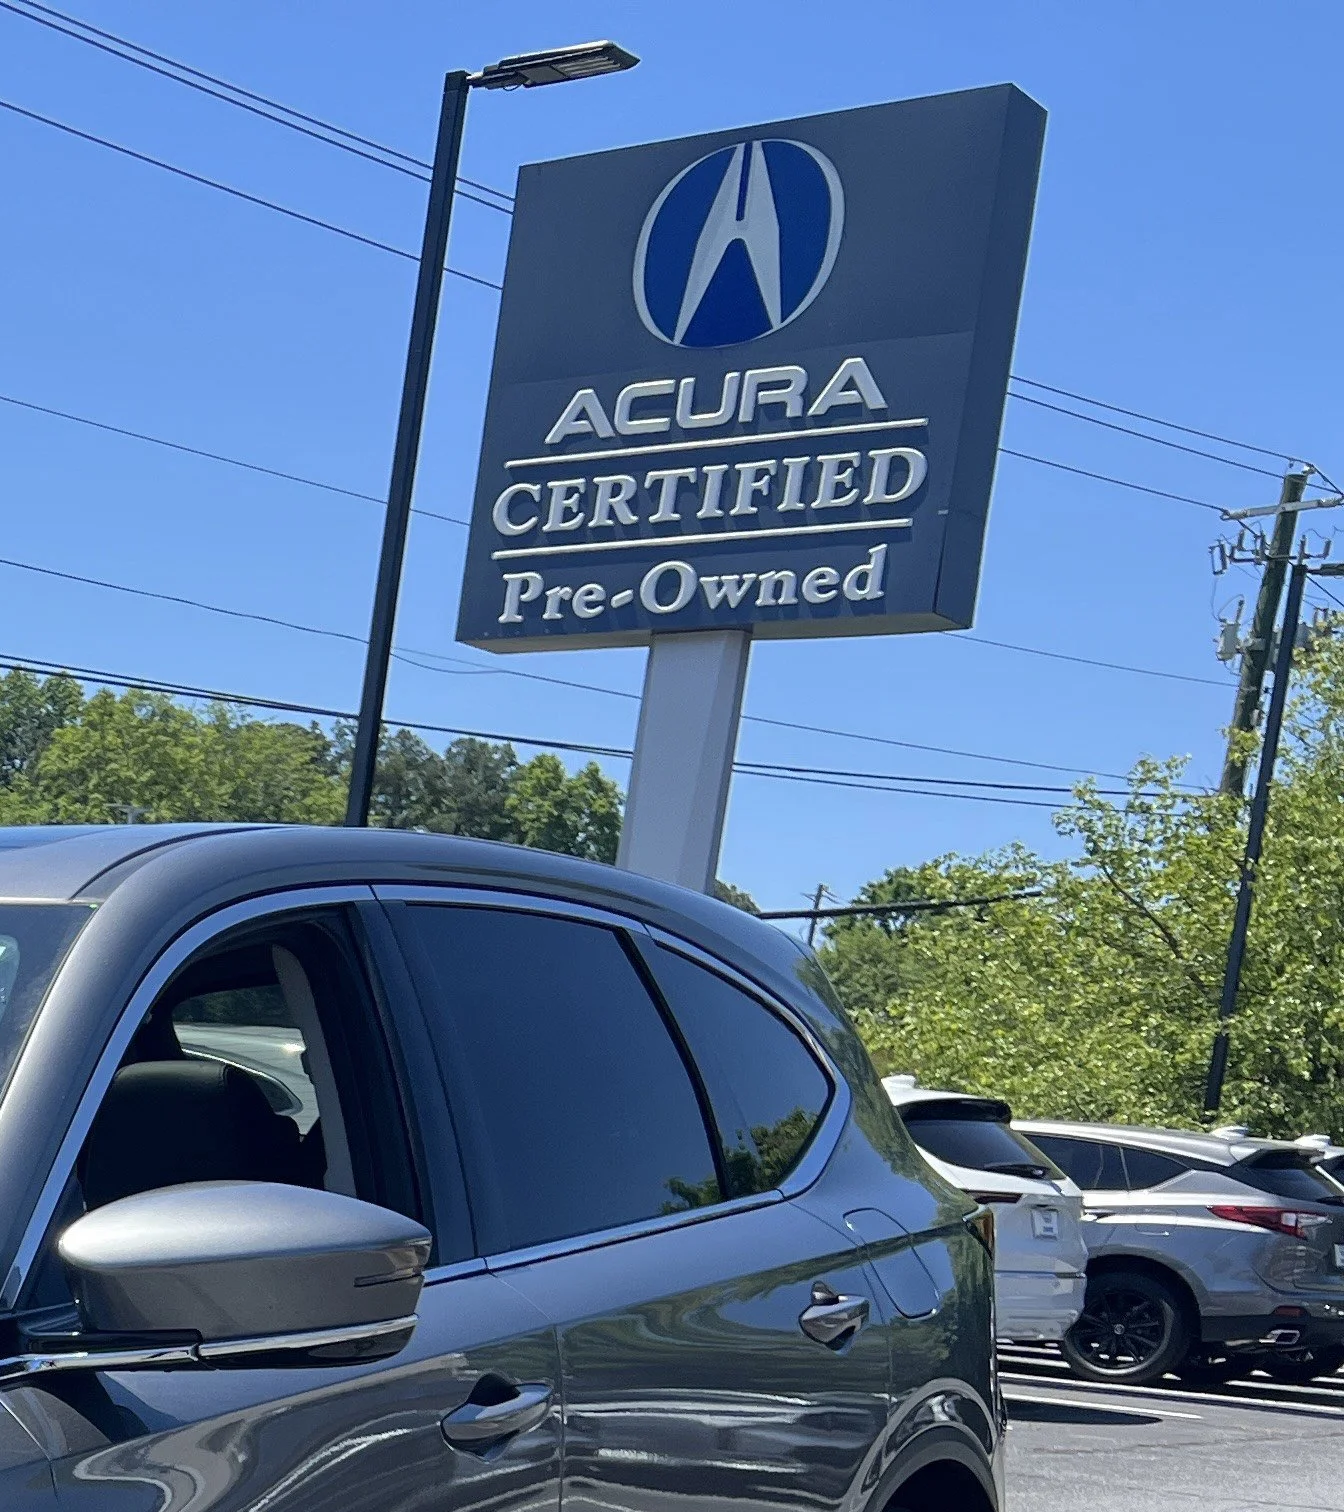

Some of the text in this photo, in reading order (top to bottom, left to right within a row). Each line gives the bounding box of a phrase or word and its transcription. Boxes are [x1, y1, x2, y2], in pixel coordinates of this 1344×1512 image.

[545, 357, 888, 445] ACURA
[492, 446, 929, 537] CERTIFIED
[498, 543, 888, 624] Pre-Owned
